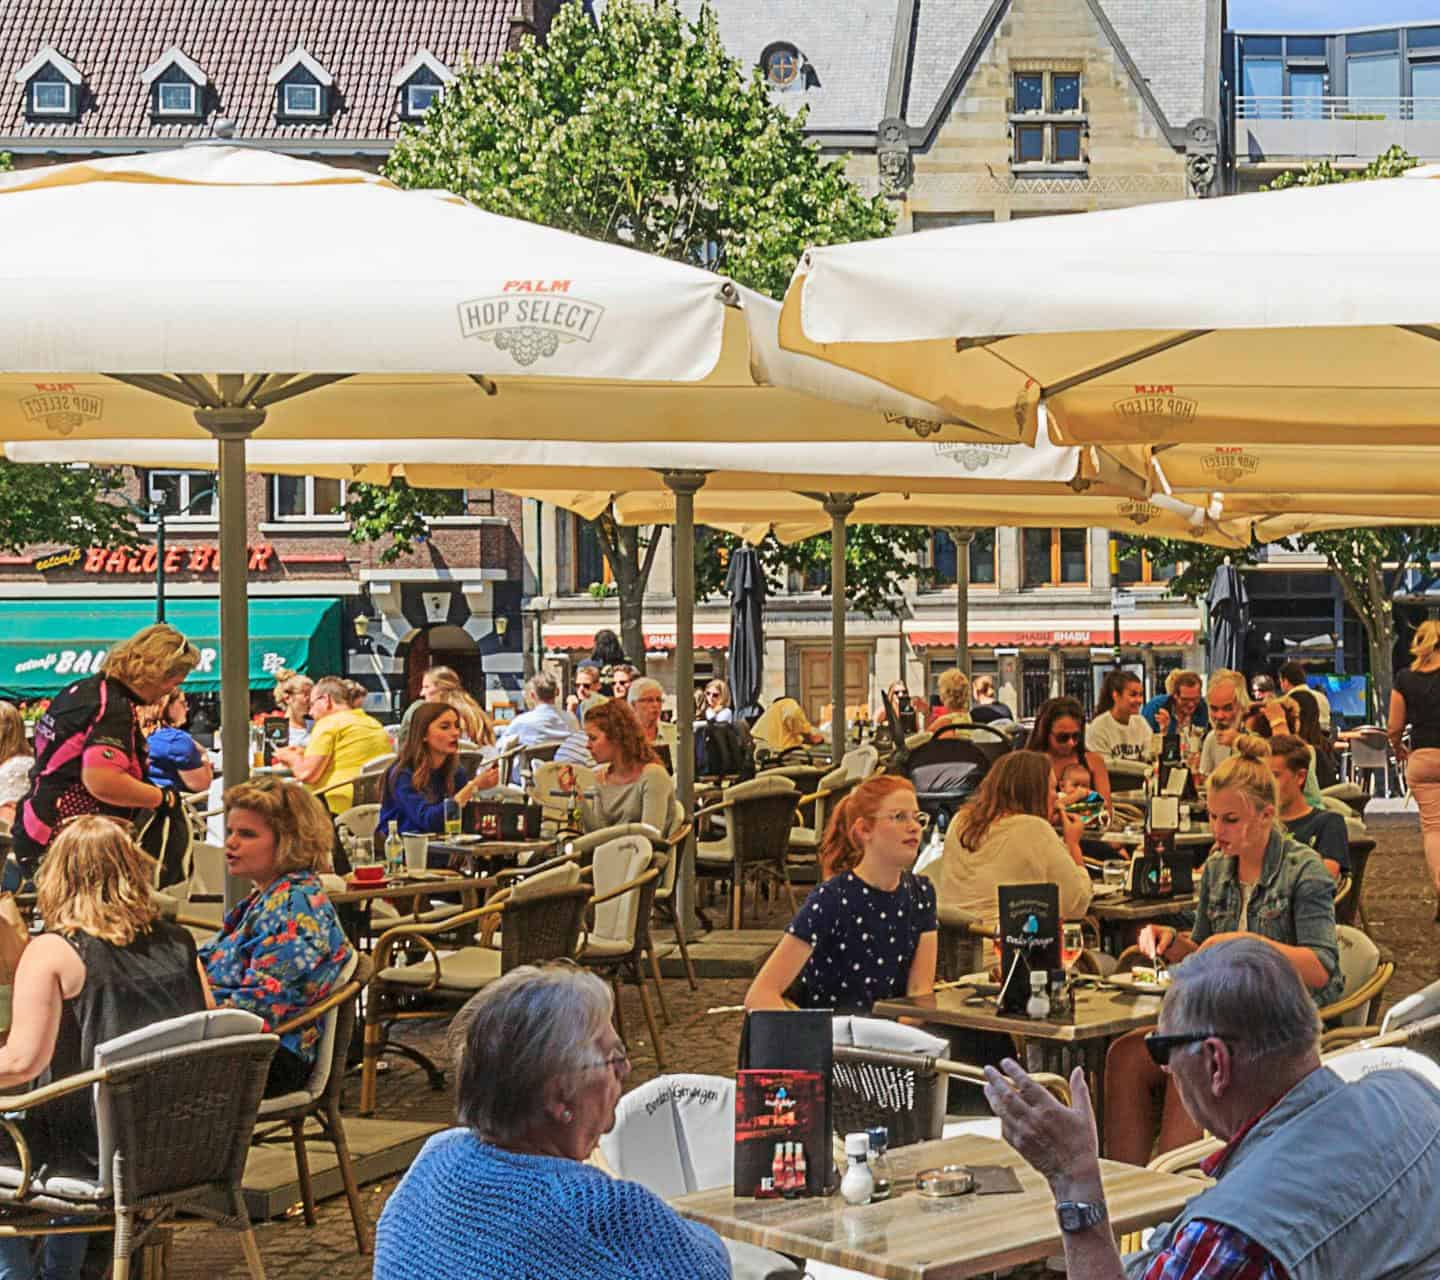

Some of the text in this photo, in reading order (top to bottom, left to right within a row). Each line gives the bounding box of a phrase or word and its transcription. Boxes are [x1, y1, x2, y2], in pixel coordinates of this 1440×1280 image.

[503, 279, 573, 294] PALM
[466, 298, 595, 333] HOP SELECT
[1052, 632, 1091, 642] SHABU
